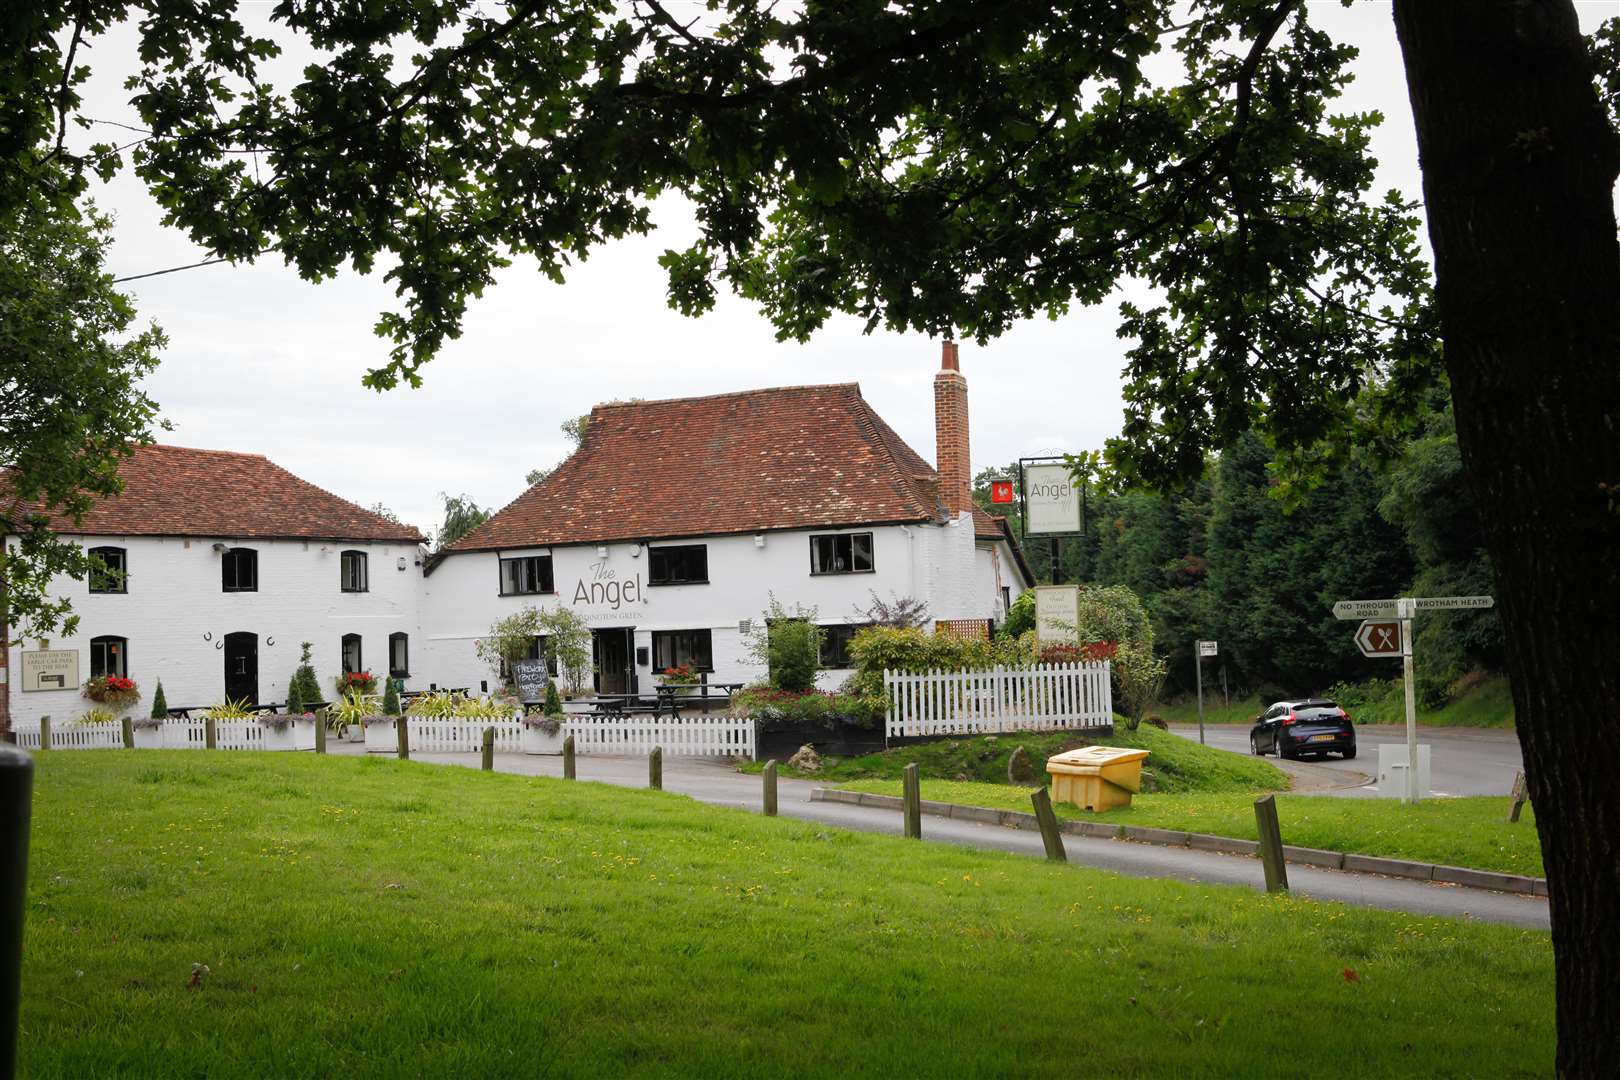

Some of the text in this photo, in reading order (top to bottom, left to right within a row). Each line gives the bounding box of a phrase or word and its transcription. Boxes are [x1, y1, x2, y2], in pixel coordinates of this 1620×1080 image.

[1030, 481, 1071, 500] Angel
[589, 560, 616, 580] The
[572, 573, 641, 610] Angel
[1355, 602, 1395, 610] THROUGH
[1416, 599, 1458, 607] WROTHAM
